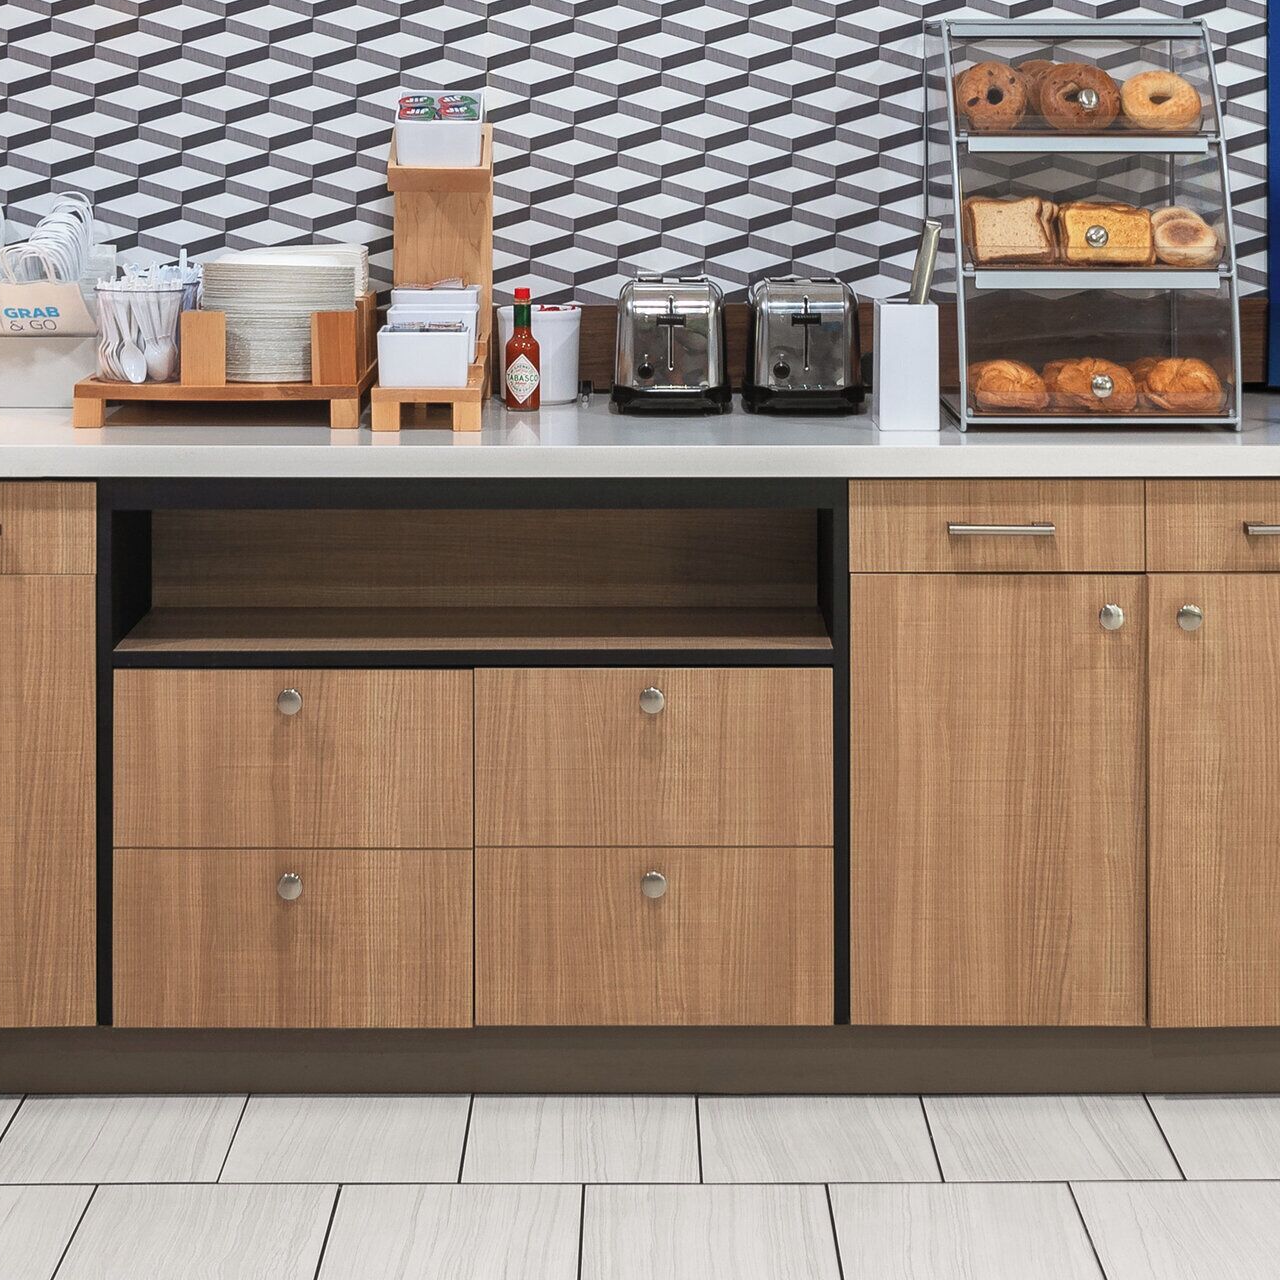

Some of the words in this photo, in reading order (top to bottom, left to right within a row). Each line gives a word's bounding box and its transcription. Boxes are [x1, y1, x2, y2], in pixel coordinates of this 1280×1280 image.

[4, 306, 60, 319] GRAB
[10, 320, 24, 331] &
[29, 319, 58, 331] GO
[507, 373, 539, 382] TABASCO
